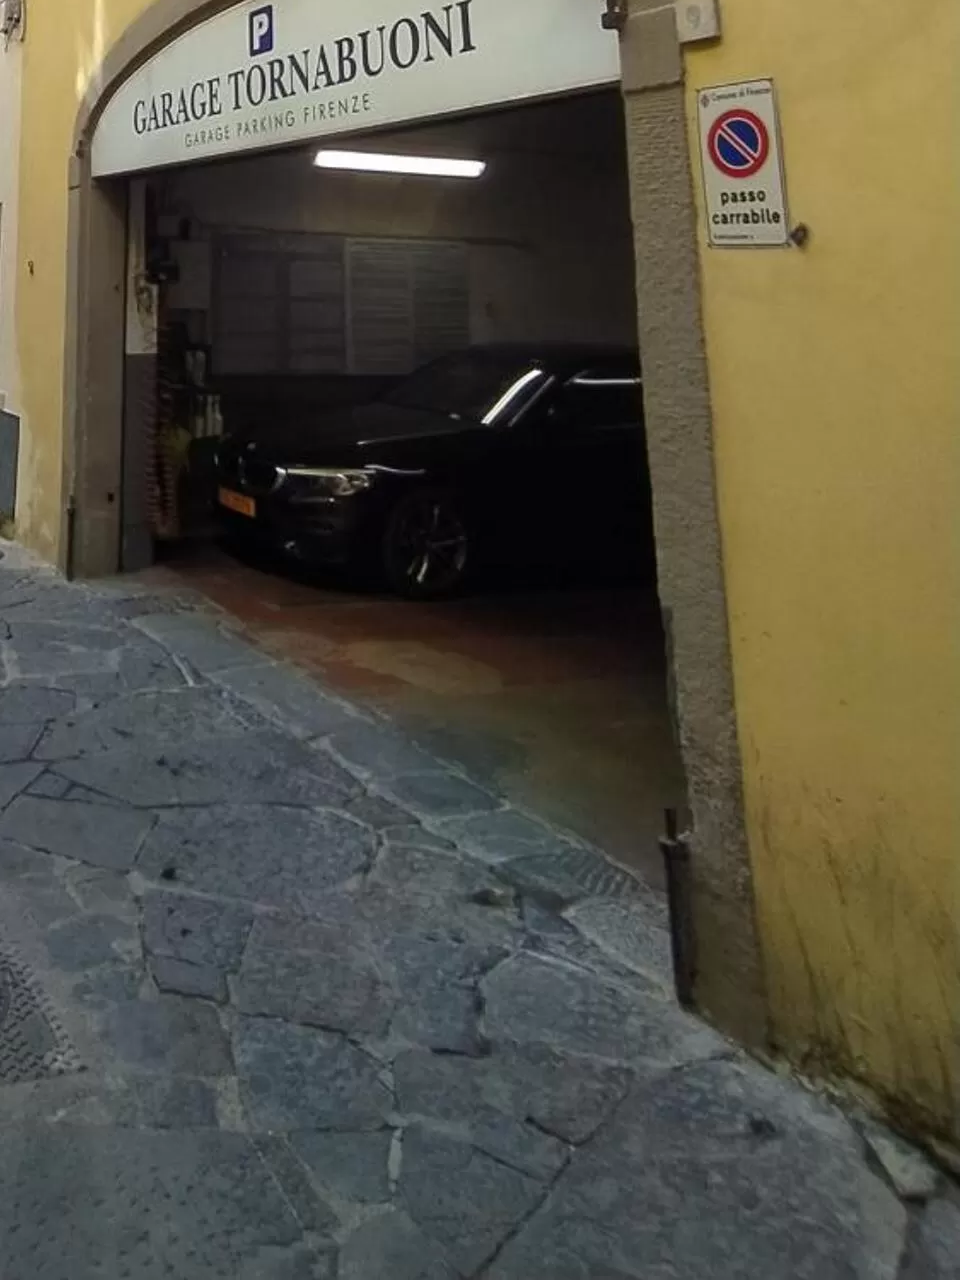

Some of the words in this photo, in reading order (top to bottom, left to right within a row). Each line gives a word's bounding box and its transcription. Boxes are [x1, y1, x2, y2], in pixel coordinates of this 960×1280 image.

[253, 12, 270, 49] P
[133, 77, 223, 136] GARAGE
[184, 127, 231, 148] GARAGE
[236, 111, 296, 138] PARKING
[303, 92, 373, 124] FIRENZE
[720, 189, 766, 206] passo
[711, 209, 781, 225] carrabile
